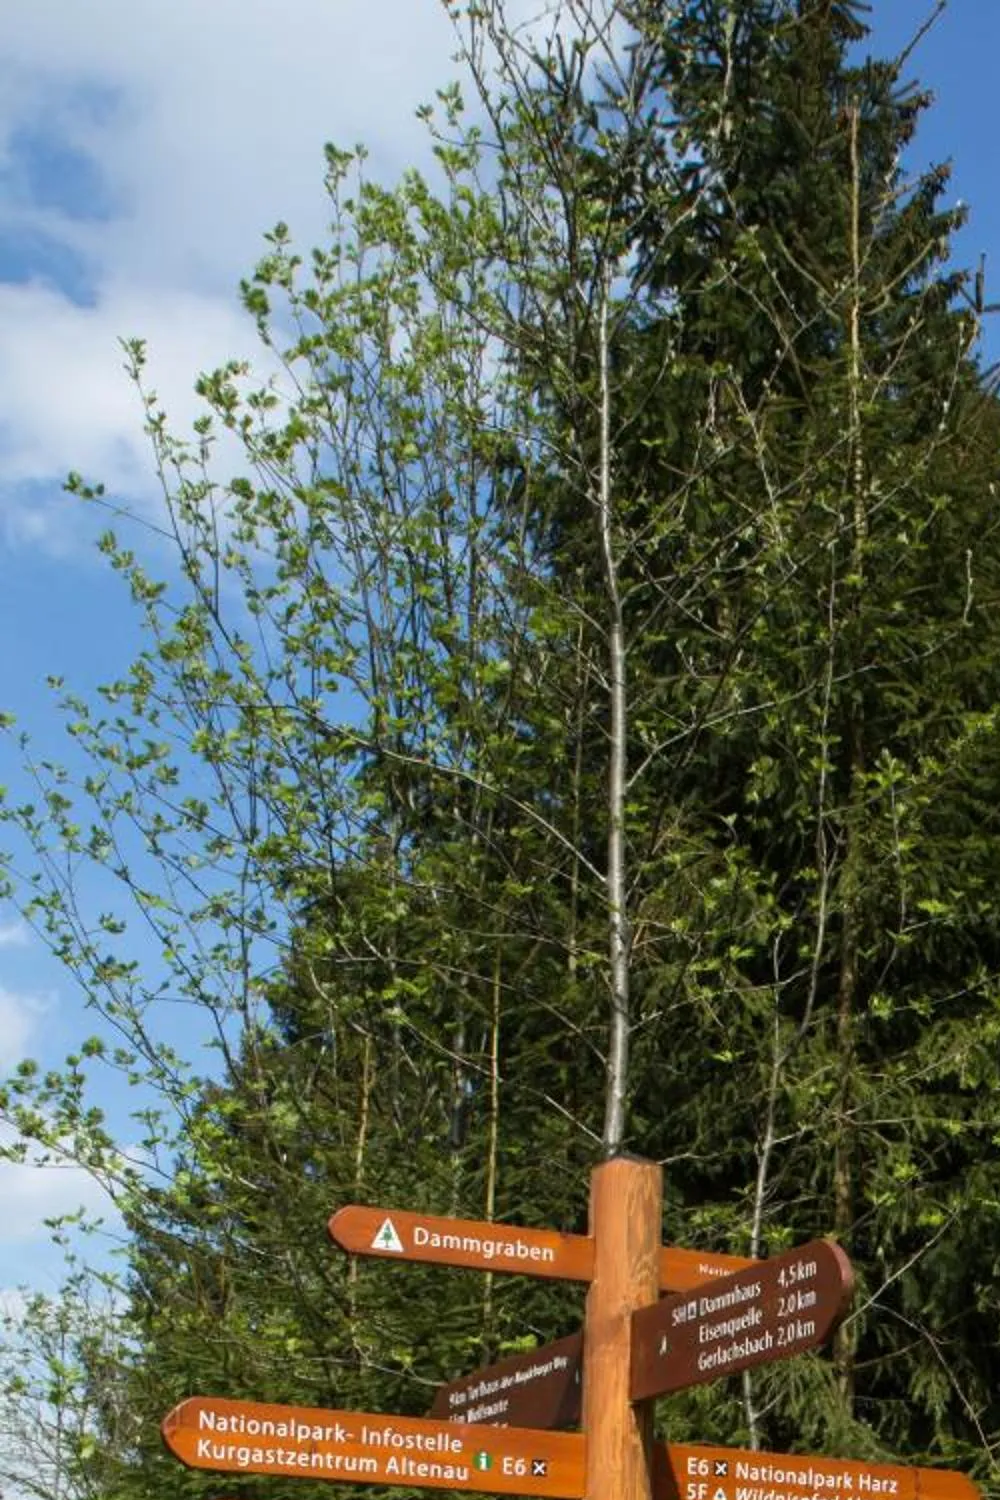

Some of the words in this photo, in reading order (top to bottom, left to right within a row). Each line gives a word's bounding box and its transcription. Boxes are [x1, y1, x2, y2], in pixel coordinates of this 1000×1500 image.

[413, 1226, 555, 1262] Dammgraben
[699, 1281, 762, 1316] Dammhaus
[777, 1263, 797, 1288] 4,5
[797, 1260, 817, 1281] km
[699, 1306, 763, 1344] Eisenquelle
[777, 1294, 796, 1317] 2,0
[797, 1289, 817, 1310] km
[698, 1331, 774, 1371] Gerlachsbach
[777, 1325, 796, 1347] 2,0
[796, 1319, 816, 1338] km
[198, 1409, 355, 1444] Nationalpark-
[361, 1425, 464, 1453] Infostelle
[197, 1439, 378, 1474] Kurgastzentrum
[385, 1455, 470, 1481] Altenau
[502, 1456, 527, 1476] E6
[686, 1456, 709, 1477] E6
[735, 1461, 853, 1490] Nationalpark
[859, 1473, 898, 1493] Harz
